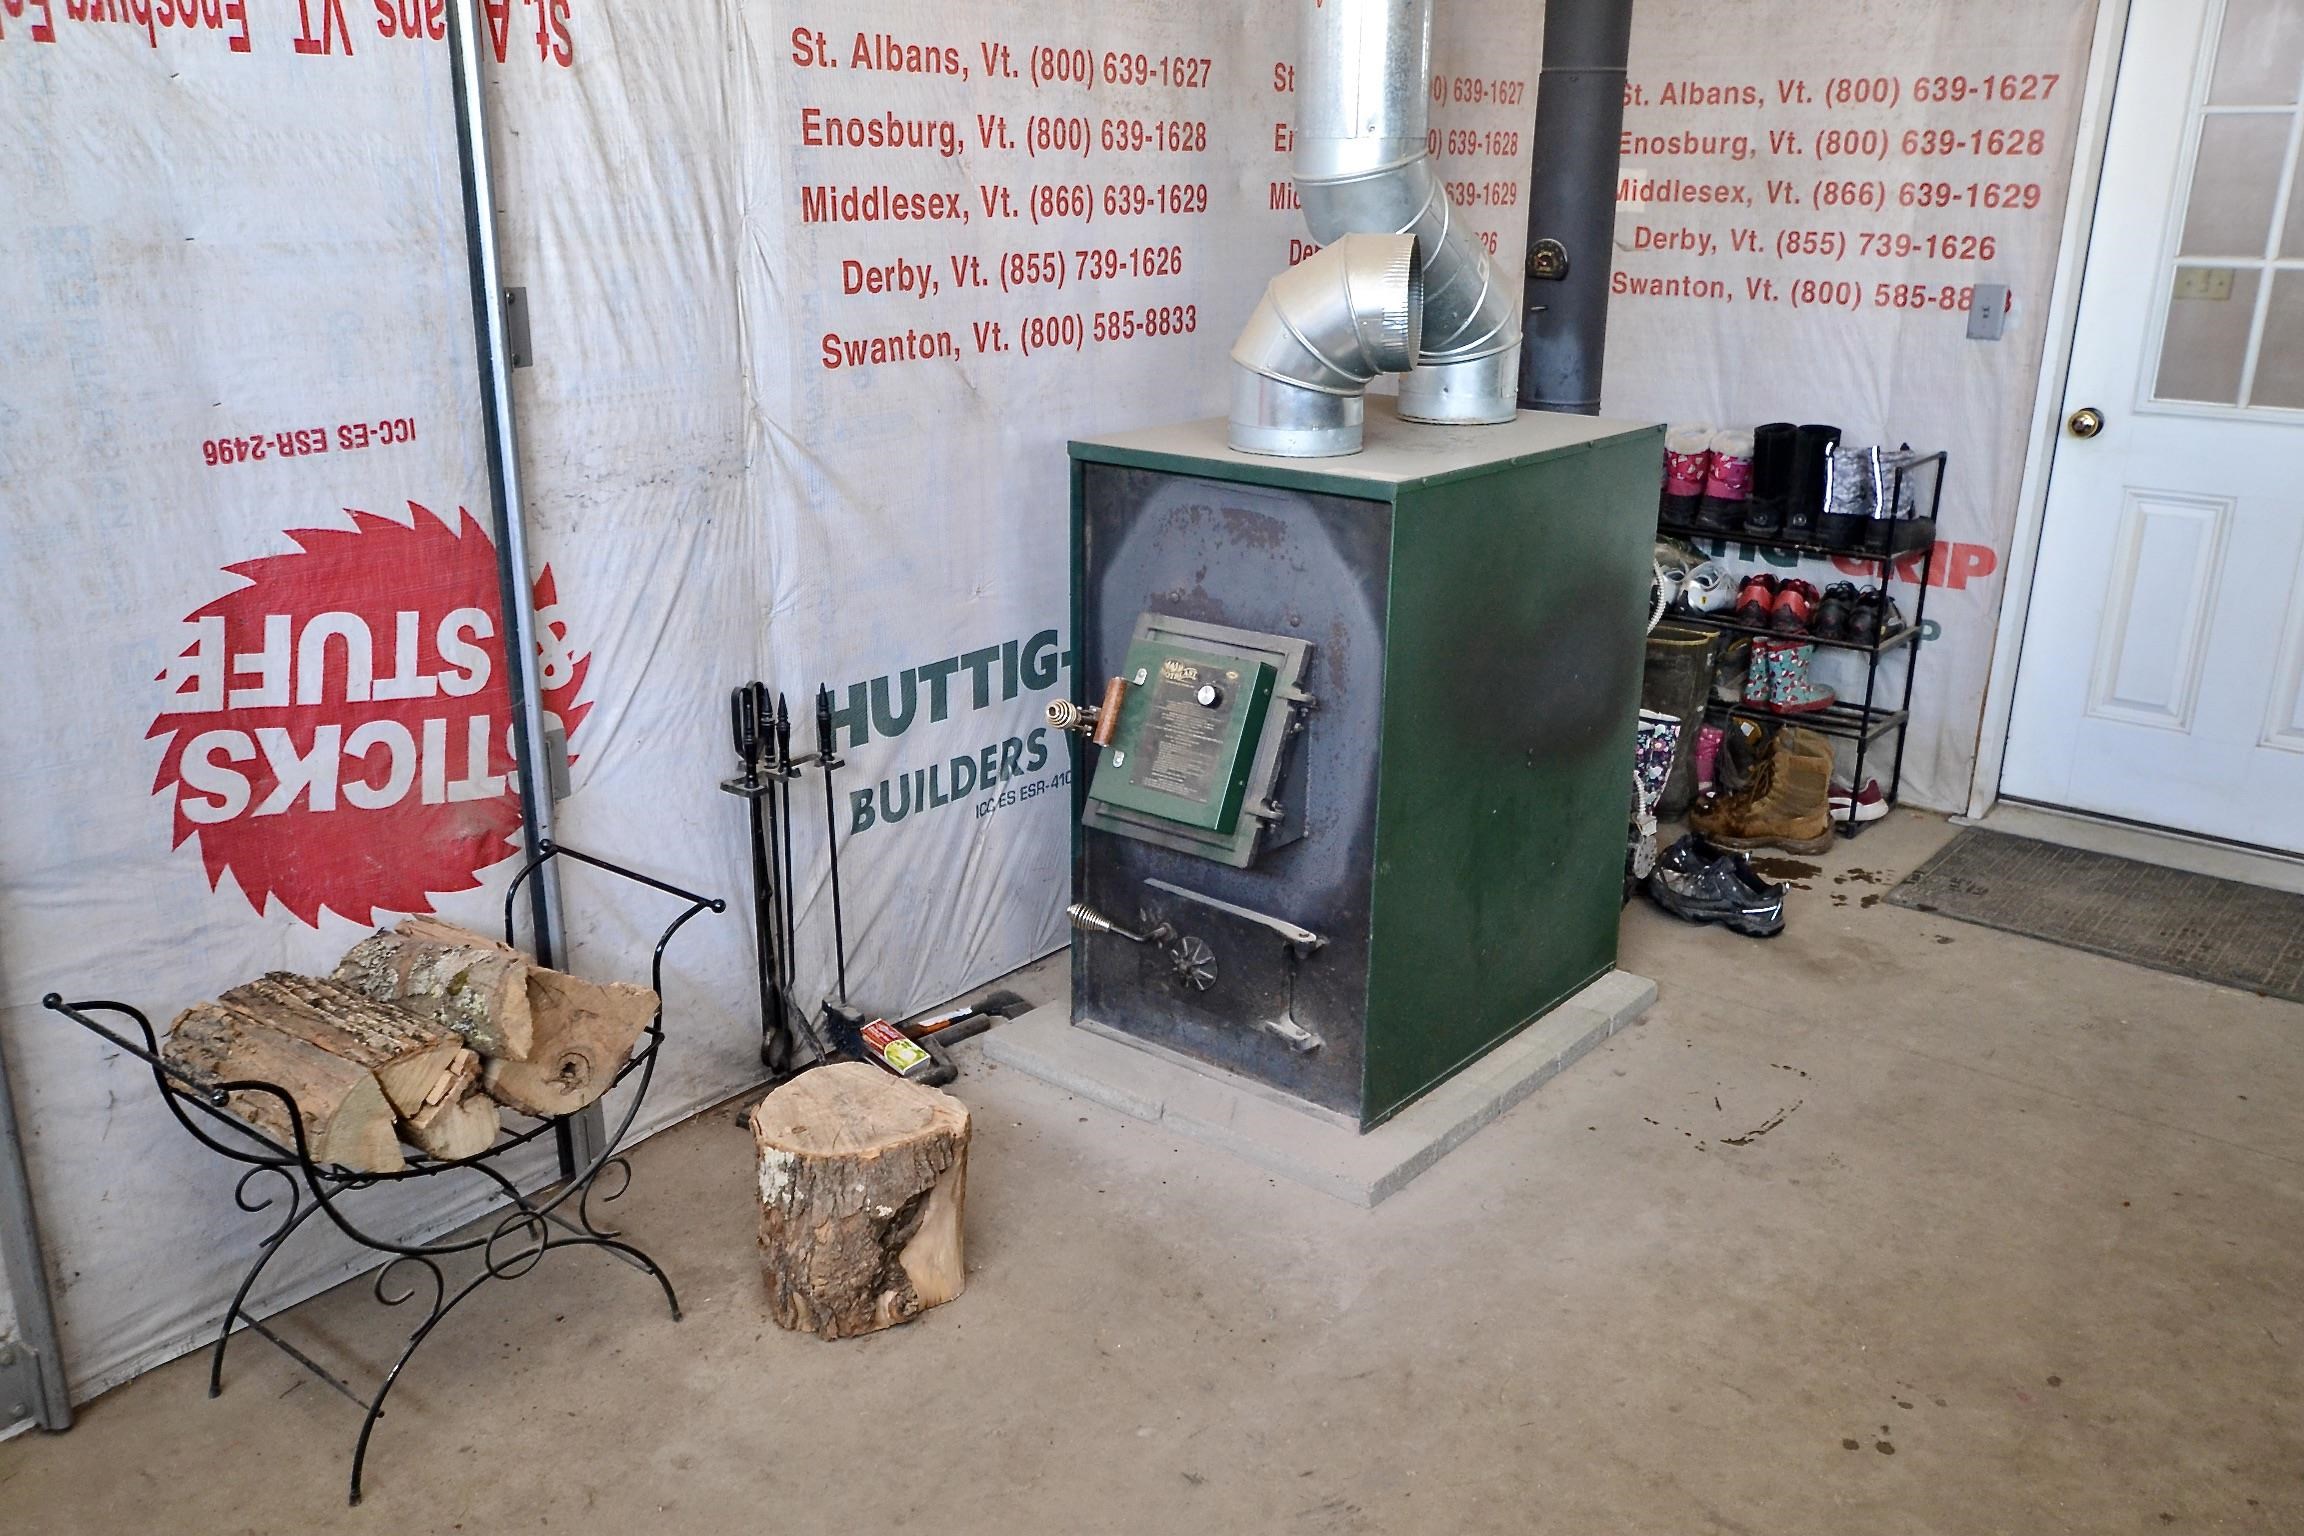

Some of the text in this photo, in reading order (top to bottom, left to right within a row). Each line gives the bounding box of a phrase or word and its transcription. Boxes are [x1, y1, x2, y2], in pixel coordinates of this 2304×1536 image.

[293, 0, 353, 56] VT
[373, 0, 511, 64] Aans
[791, 27, 1212, 90] St. Albans, Vt. (800) 639-1627
[1275, 63, 1294, 92] St
[1454, 80, 1523, 104] 639-1627
[1660, 81, 1764, 108] Albans,
[1777, 80, 1812, 104] Vt.
[1825, 78, 1900, 107] (800)
[1915, 74, 2059, 102] 639-1627
[801, 107, 1206, 158] Enosburg, Vt. (800) 639-1628
[1449, 130, 1518, 156] 639-1628
[1620, 129, 2044, 160] Enosburg, Vt. (800) 639-1628
[802, 184, 1207, 224] Middlesex, Vt. (866) 639-1629
[1446, 182, 1517, 207] 639-1629
[1767, 180, 1800, 204] Vt.
[1814, 181, 1885, 209] (866)
[1899, 182, 2041, 208] 639-1629
[1634, 225, 1994, 260] Derby, Vt. (855) 739-1626
[842, 245, 1182, 299] Derby, Vt. (855) 739-1626
[1611, 272, 2011, 312] Swanton, Vt. (800) 585-88
[821, 304, 1197, 369] Swanton, Vt. (800) 585-8833
[202, 417, 416, 467] ICC-ES ESR-2496
[160, 607, 496, 713] STUFF
[850, 727, 1047, 835] BUILDERS
